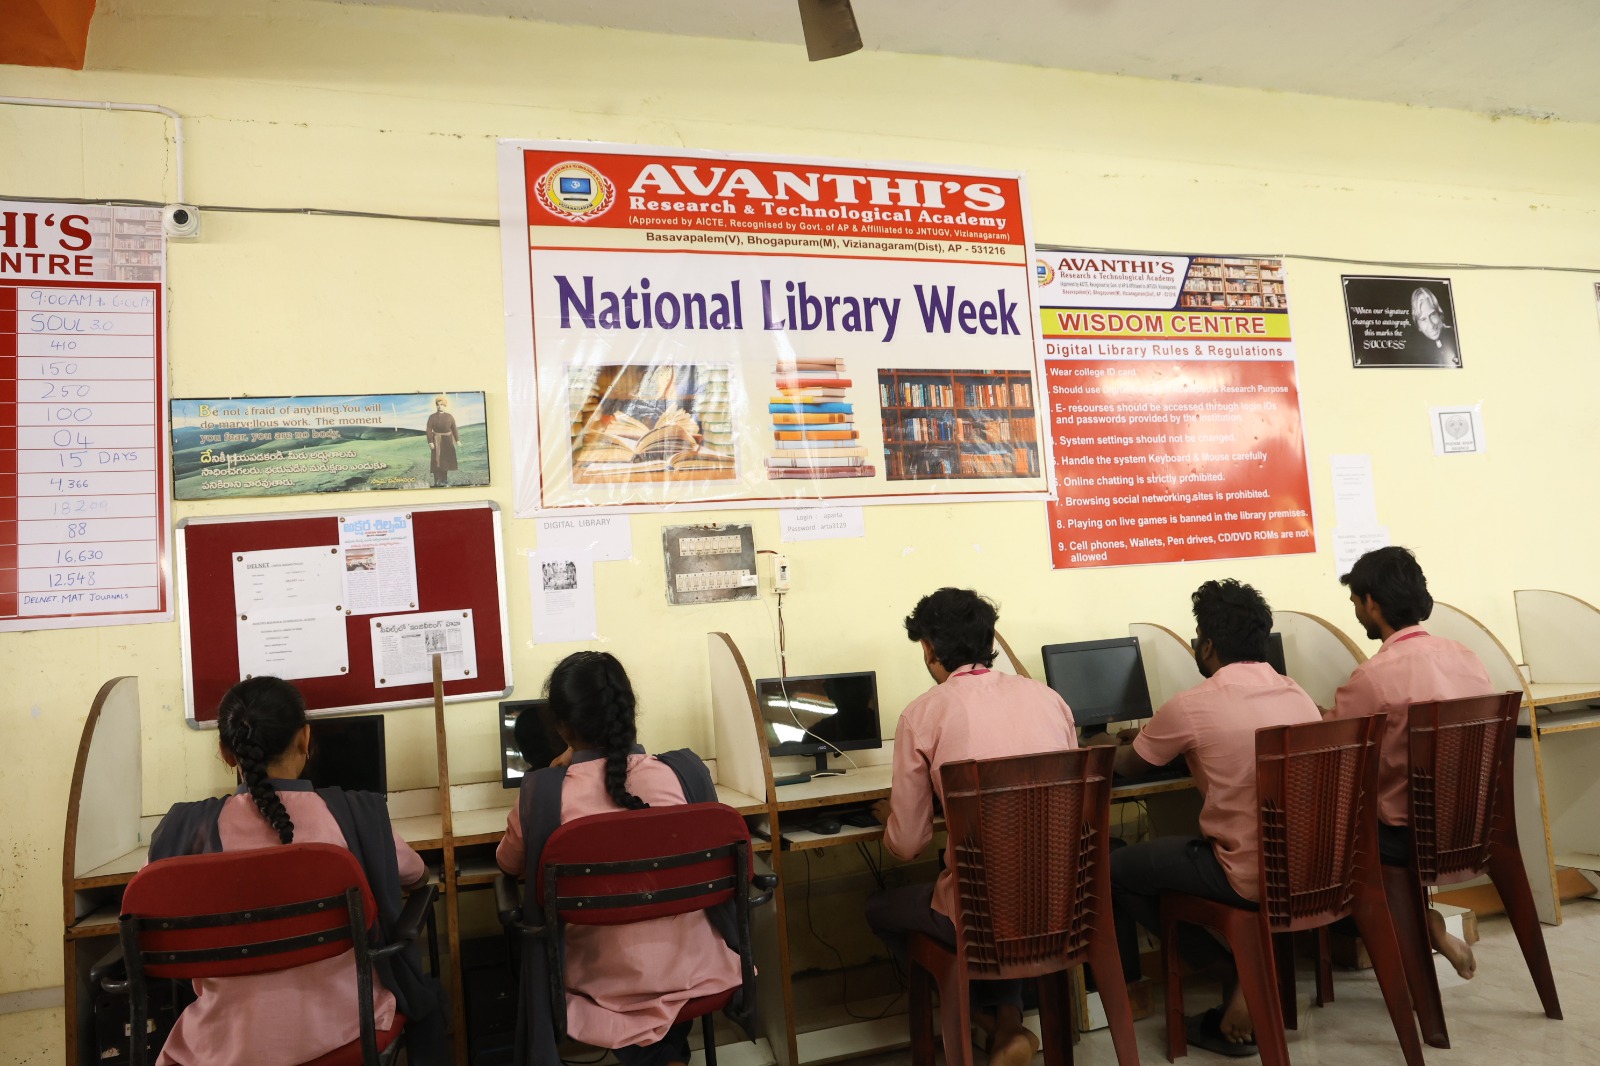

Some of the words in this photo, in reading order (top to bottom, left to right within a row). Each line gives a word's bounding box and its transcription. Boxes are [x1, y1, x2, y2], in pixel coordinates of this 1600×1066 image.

[628, 164, 1006, 212] AVANTHI'S
[629, 196, 737, 214] Research
[743, 204, 755, 214] &
[761, 202, 912, 224] Technological
[917, 210, 1006, 230] Academy
[628, 216, 679, 226] (Approved
[681, 217, 692, 226] by
[695, 218, 728, 228] AICTE,
[730, 219, 784, 230] Recognised
[786, 221, 798, 231] by
[799, 222, 823, 232] Govt.
[825, 222, 834, 231] of
[836, 223, 850, 232] AP
[852, 224, 858, 232] &
[905, 226, 914, 235] to
[916, 227, 952, 238] JNTUGV,
[954, 228, 1010, 242] Vizianagaram)
[646, 232, 744, 246] Basavapalem(V),
[747, 236, 840, 250] Bhogapuram(M),
[842, 240, 945, 254] Vizianagaram(Dist),
[948, 244, 962, 253] AP
[972, 246, 1006, 256] 531216
[0, 252, 94, 276] NTRE
[1058, 258, 1175, 274] AVANTHI'S
[1060, 272, 1091, 280] Research
[1099, 272, 1144, 282] Technological
[1146, 274, 1175, 283] Academy
[553, 276, 744, 330] National
[760, 280, 901, 342] Library
[914, 284, 1020, 335] Week
[31, 313, 85, 332] SOUL
[1057, 313, 1164, 332] WISDOM
[1171, 316, 1266, 334] CENTRE
[1352, 318, 1374, 328] changes
[50, 340, 76, 350] 410
[1046, 343, 1092, 358] Digital
[1099, 344, 1148, 358] Library
[1152, 344, 1189, 356] Rules
[1194, 345, 1204, 356] &
[1208, 344, 1283, 358] Regulations
[42, 362, 78, 375] 150
[1050, 368, 1072, 376] Wear
[1074, 368, 1104, 378] college
[1107, 368, 1116, 376] ID
[1118, 368, 1136, 376] card
[41, 382, 90, 399] 250
[1052, 386, 1083, 394] Should
[1258, 384, 1288, 394] Purpose
[47, 408, 92, 422] 100
[223, 408, 242, 416] not
[280, 406, 290, 414] of
[364, 404, 381, 412] will
[1056, 404, 1066, 412] E-
[1068, 404, 1114, 412] resourses
[1116, 402, 1146, 412] should
[1150, 402, 1161, 411] be
[1163, 402, 1204, 410] accessed
[1206, 402, 1238, 412] through
[218, 419, 279, 429] marvellous
[282, 418, 311, 426] work.
[315, 418, 335, 426] The
[339, 416, 382, 425] moment
[1056, 415, 1074, 424] and
[1076, 415, 1128, 426] passwords
[1129, 414, 1168, 424] provided
[1170, 414, 1180, 424] by
[54, 430, 94, 449] 04
[200, 433, 221, 442] you
[251, 432, 272, 442] you
[274, 431, 292, 439] are
[1060, 436, 1094, 447] System
[1096, 436, 1134, 446] settings
[1136, 434, 1166, 444] should
[1169, 435, 1183, 443] not
[1185, 434, 1196, 442] be
[60, 450, 88, 468] 15
[98, 451, 138, 464] DAYS
[1062, 456, 1094, 466] Handle
[1096, 455, 1112, 464] the
[1114, 456, 1146, 467] system
[1148, 453, 1190, 465] Keyboard
[1202, 452, 1230, 462] Mouse
[1232, 451, 1268, 462] carefully
[1064, 476, 1094, 486] Online
[1096, 476, 1134, 488] chatting
[1136, 476, 1144, 484] is
[1146, 473, 1178, 486] strictly
[1180, 472, 1225, 484] prohibited.
[1066, 496, 1110, 508] Browsing
[1112, 494, 1140, 504] social
[1142, 492, 1191, 505] networking
[1192, 491, 1214, 502] sites
[1216, 491, 1224, 500] is
[1226, 488, 1270, 502] prohibited.
[544, 520, 576, 530] DIGITAL
[578, 518, 611, 528] LIBRARY
[1056, 520, 1066, 530] 8.
[1067, 518, 1102, 531] Playing
[1120, 516, 1136, 526] live
[1138, 516, 1167, 528] games
[1170, 514, 1178, 524] is
[1180, 512, 1212, 523] banned
[1214, 512, 1222, 521] in
[1224, 511, 1238, 520] the
[1240, 510, 1266, 523] library
[1268, 508, 1308, 520] premises.
[68, 522, 87, 538] 88
[788, 524, 816, 532] Password
[1058, 542, 1067, 552] 9.
[1069, 540, 1088, 551] Cell
[1090, 540, 1128, 552] phones,
[1130, 536, 1165, 548] Wallets,
[1168, 536, 1184, 546] Pen
[1186, 534, 1216, 546] drives,
[1218, 532, 1252, 544] CD/DVD
[1254, 530, 1279, 540] ROMs
[1280, 531, 1294, 539] are
[1296, 529, 1309, 538] not
[1070, 551, 1108, 562] allowed
